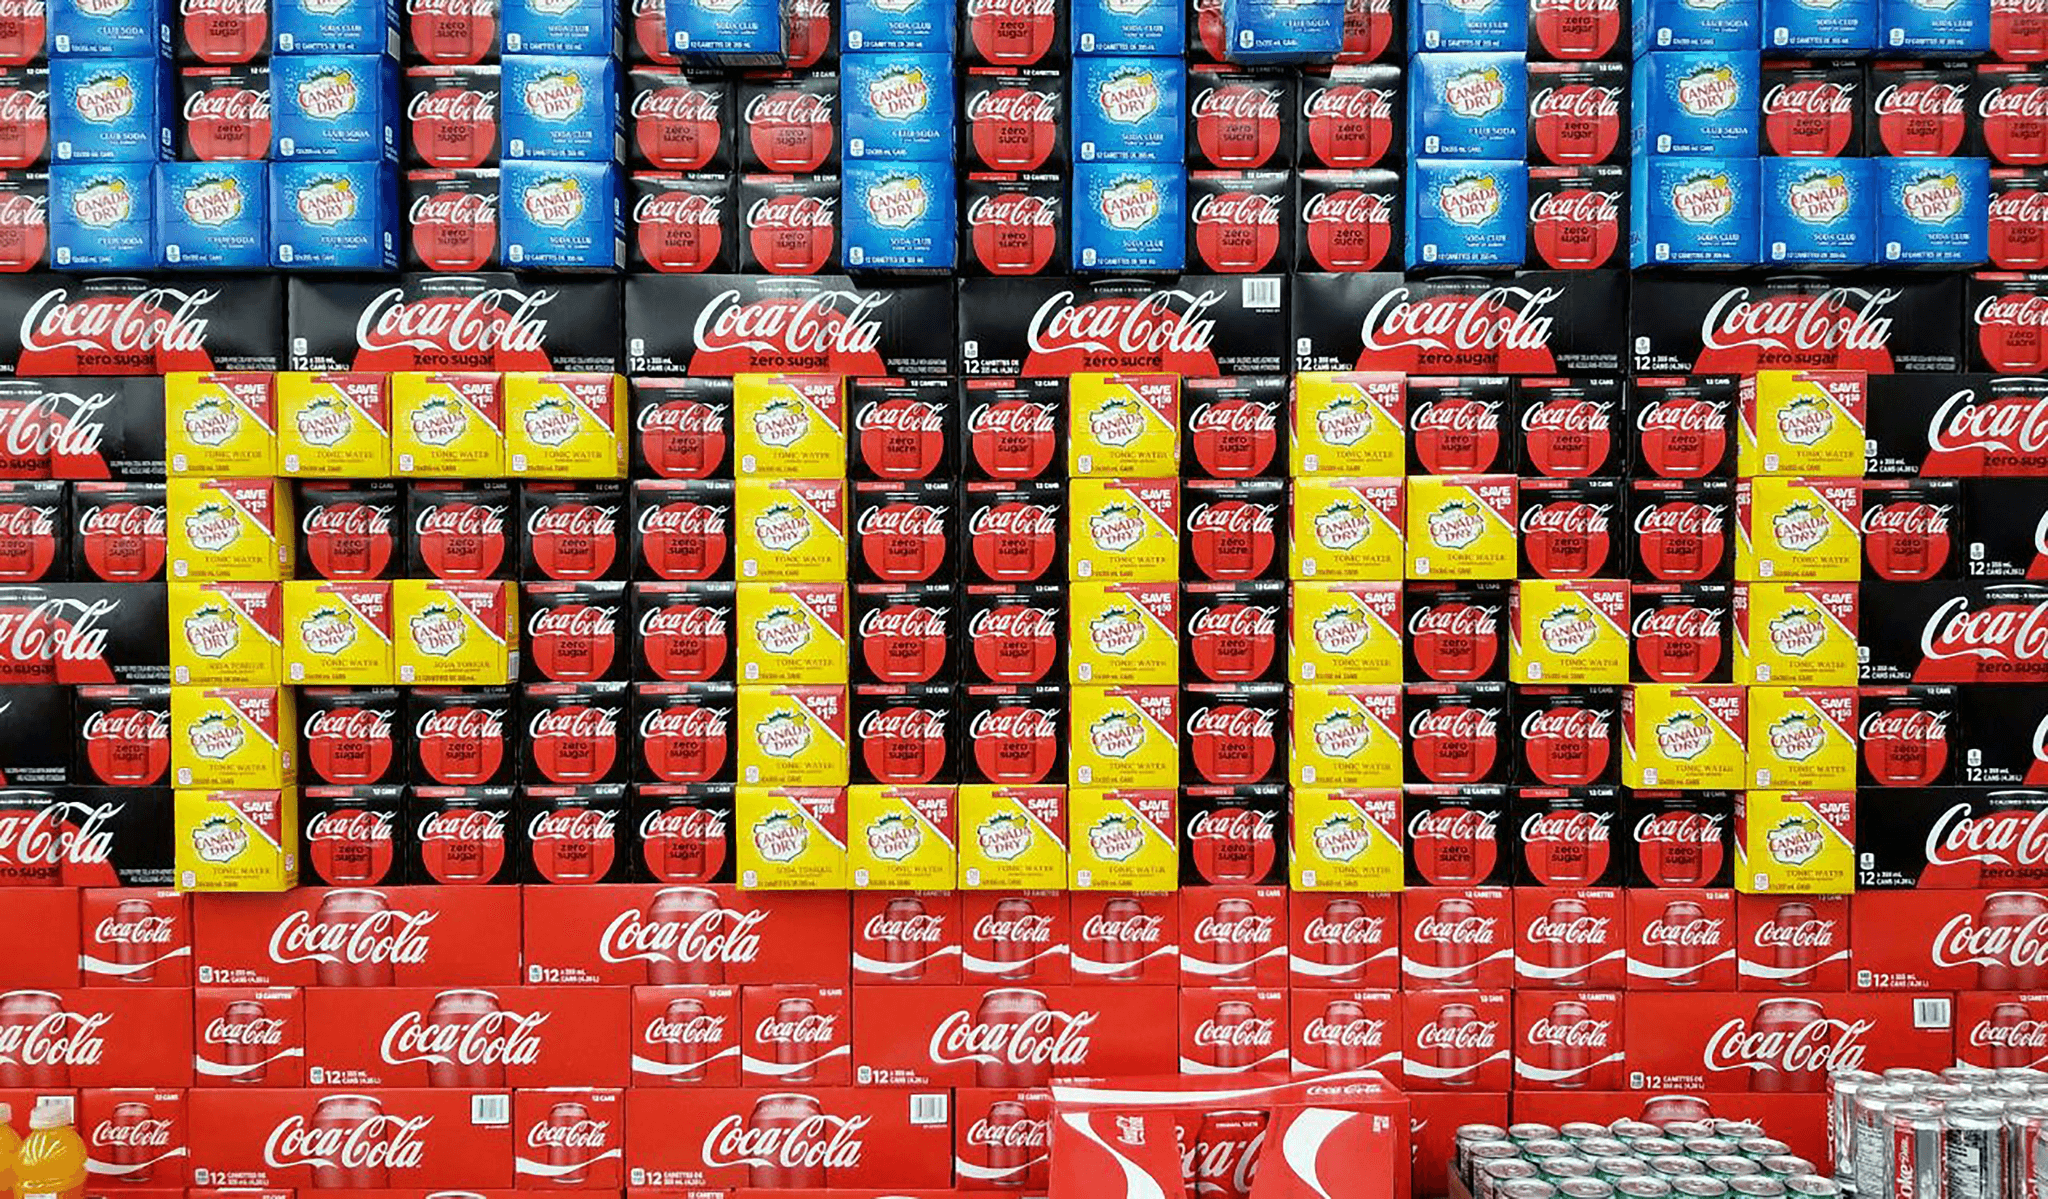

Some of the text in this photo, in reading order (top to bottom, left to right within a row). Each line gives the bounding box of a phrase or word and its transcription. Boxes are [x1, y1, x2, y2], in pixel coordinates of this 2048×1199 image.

[78, 87, 130, 111] CANADA
[1447, 80, 1503, 105] CANADA
[1679, 78, 1736, 102] CANADA
[1697, 92, 1726, 109] DRY
[1763, 84, 1856, 114] Coca-Cola
[94, 101, 123, 117] DRY
[408, 91, 498, 121] Coca-Cola
[632, 89, 721, 120] Coca-Cola
[968, 90, 1059, 121] Coca-Cola
[1464, 95, 1493, 111] DRY
[1531, 87, 1622, 117] Coca-Cola
[186, 191, 240, 214] CANADA
[526, 190, 582, 213] CANADA
[634, 194, 724, 225] Coca-Cola
[870, 189, 925, 212] CANADA
[1303, 193, 1394, 223] Coca-Cola
[1530, 192, 1621, 222] Coca-Cola
[1904, 187, 1959, 210] CANADA
[1922, 200, 1950, 217] DRY
[203, 204, 231, 220] DRY
[543, 204, 571, 220] DRY
[886, 203, 914, 219] DRY
[20, 289, 219, 351] Coca-Cola
[357, 287, 558, 351] Coca-Cola
[694, 289, 892, 352] Coca-Cola
[1028, 289, 1227, 353] Coca-Cola
[1362, 287, 1564, 350] Coca-Cola
[1702, 287, 1901, 349] Coca-Cola
[77, 354, 155, 367] zero sugar
[293, 357, 308, 370] 12
[413, 355, 495, 368] zero sugar
[750, 356, 830, 370] zero sugar
[964, 360, 979, 374] 12
[1121, 357, 1162, 367] sucre
[1417, 354, 1498, 367] zero sugar
[1635, 356, 1651, 370] 12
[1757, 352, 1838, 366] zero sugar
[348, 384, 379, 395] SAVE
[805, 385, 836, 396] SAVE
[1141, 385, 1172, 396] SAVE
[186, 411, 239, 432] CANADA
[526, 411, 579, 432] CANADA
[637, 403, 728, 432] Coca-Cola
[856, 402, 947, 432] Coca-Cola
[1092, 412, 1145, 433] CANADA
[1189, 402, 1279, 432] Coca-Cola
[1411, 401, 1503, 431] Coca-Cola
[1637, 401, 1729, 431] Coca-Cola
[1928, 389, 2048, 452] Coca-C
[201, 423, 228, 439] DRY
[541, 423, 568, 439] DRY
[1107, 424, 1134, 440] DRY
[236, 489, 267, 500] SAVE
[1480, 486, 1511, 497] SAVE
[1826, 488, 1857, 499] SAVE
[303, 506, 392, 534] Coca-Cola
[528, 506, 618, 535] Coca-Cola
[969, 505, 1059, 535] Coca-Cola
[1521, 504, 1612, 533] Coca-Cola
[1861, 505, 1951, 533] Coca-Cola
[1969, 562, 1984, 575] 12
[352, 594, 383, 605] SAVE
[1141, 593, 1172, 604] SAVE
[1593, 592, 1624, 603] SAVE
[303, 620, 356, 641] CANADA
[1189, 606, 1279, 636] Coca-Cola
[1316, 620, 1369, 641] CANADA
[1632, 608, 1725, 637] Coca-Cola
[318, 632, 345, 648] DRY
[1331, 632, 1358, 648] DRY
[239, 698, 270, 709] SAVE
[1709, 698, 1740, 709] SAVE
[1821, 698, 1852, 709] SAVE
[304, 710, 394, 738] Coca-Cola
[859, 710, 948, 738] Coca-Cola
[1410, 708, 1499, 738] Coca-Cola
[1860, 711, 1950, 740] Coca-Cola
[191, 725, 244, 746] CANADA
[206, 737, 233, 753] DRY
[1659, 725, 1712, 746] CANADA
[1674, 737, 1701, 753] DRY
[917, 799, 948, 810] SAVE
[1139, 800, 1170, 811] SAVE
[1819, 803, 1850, 814] SAVE
[640, 809, 729, 839] Coca-Cola
[1521, 812, 1613, 842] Coca-Cola
[868, 826, 921, 847] CANADA
[883, 838, 910, 854] DRY
[1859, 871, 1875, 885] 12
[95, 917, 172, 943] Coca-Cola
[269, 909, 438, 963] Coca-Cola
[600, 908, 769, 963] Coca-Cola
[864, 915, 944, 941] Coca-Cola
[1083, 915, 1163, 941] Coca-Cola
[1304, 917, 1383, 944] Coca-Cola
[1528, 917, 1610, 943] Coca-Cola
[1643, 920, 1723, 945] Coca-Cola
[1755, 921, 1833, 946] Coca-Cola
[214, 970, 229, 983] 12
[1874, 974, 1889, 987] 12
[205, 1018, 284, 1044] Coca-Cola
[381, 1010, 549, 1065] Coca-Cola
[645, 1016, 725, 1043] Coca-Cola
[930, 1011, 1098, 1064] Coca-Cola
[1418, 1022, 1497, 1048] Coca-Cola
[1704, 1018, 1877, 1071] Coca-Cola
[873, 1071, 888, 1084] 12
[265, 1115, 432, 1167] Coca-Cola
[528, 1121, 608, 1147] Coca-Cola
[702, 1113, 870, 1167] Coca-Cola
